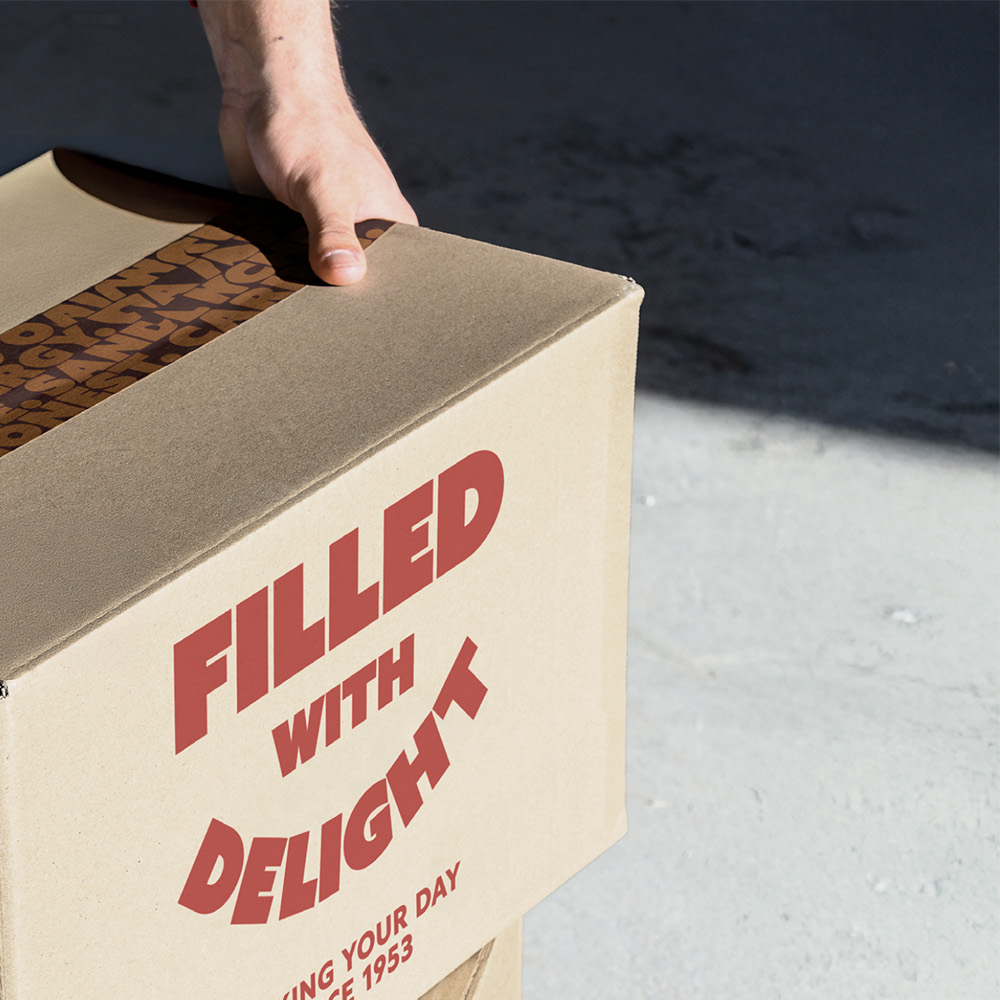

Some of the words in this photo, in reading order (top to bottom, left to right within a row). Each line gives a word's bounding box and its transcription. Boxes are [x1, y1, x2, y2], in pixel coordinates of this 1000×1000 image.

[174, 450, 504, 755] FILLED
[272, 633, 416, 777] WITH
[178, 636, 490, 925] DELIGHT
[340, 904, 409, 973] YOUR
[415, 860, 462, 919] DAY
[361, 933, 415, 992] 1953
